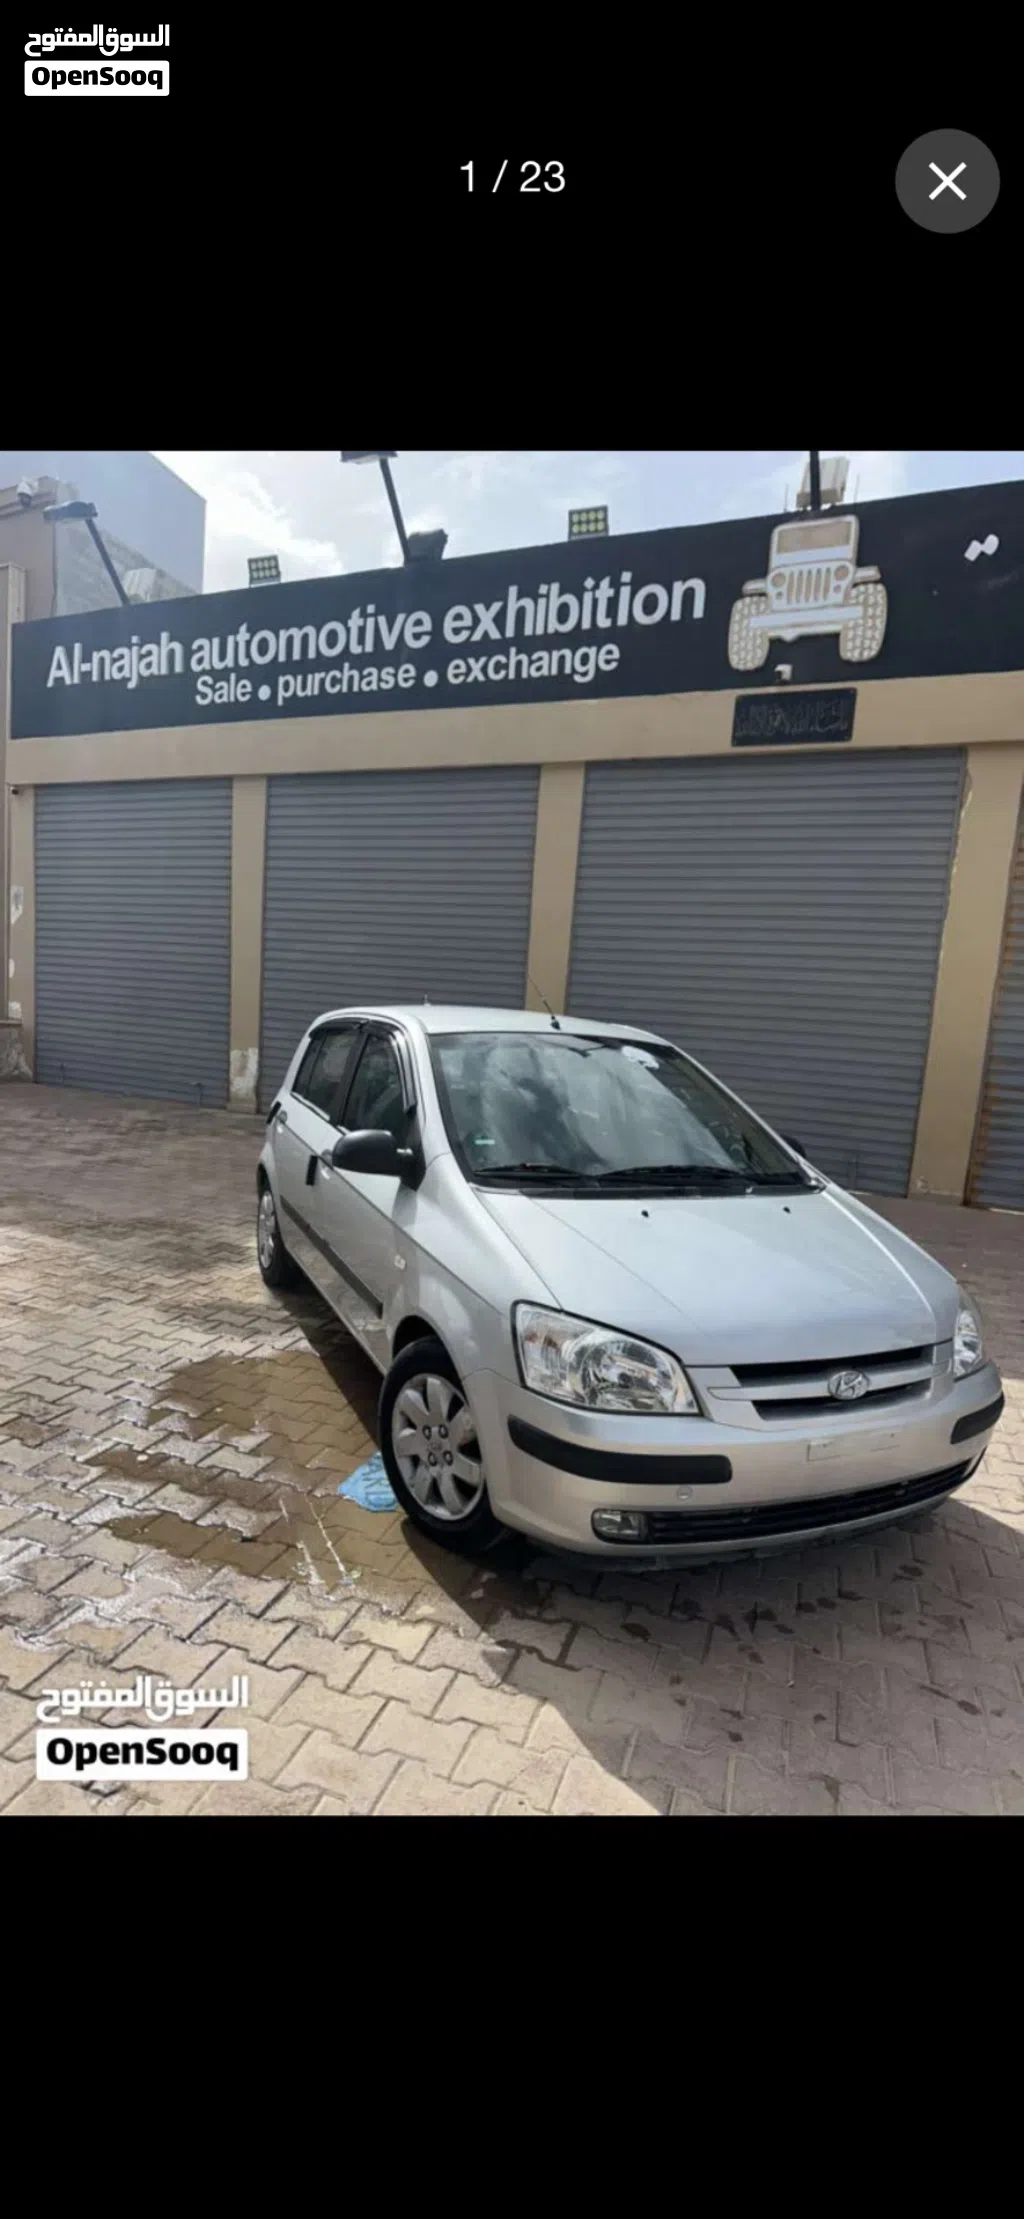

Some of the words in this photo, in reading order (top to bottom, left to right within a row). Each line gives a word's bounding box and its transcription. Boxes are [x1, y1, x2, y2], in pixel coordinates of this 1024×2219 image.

[47, 632, 184, 689] Al-najah
[190, 604, 432, 673] automotive
[443, 571, 706, 644] exhibition
[195, 673, 252, 706] Sale
[277, 662, 416, 706] purchase
[446, 643, 620, 684] exchange
